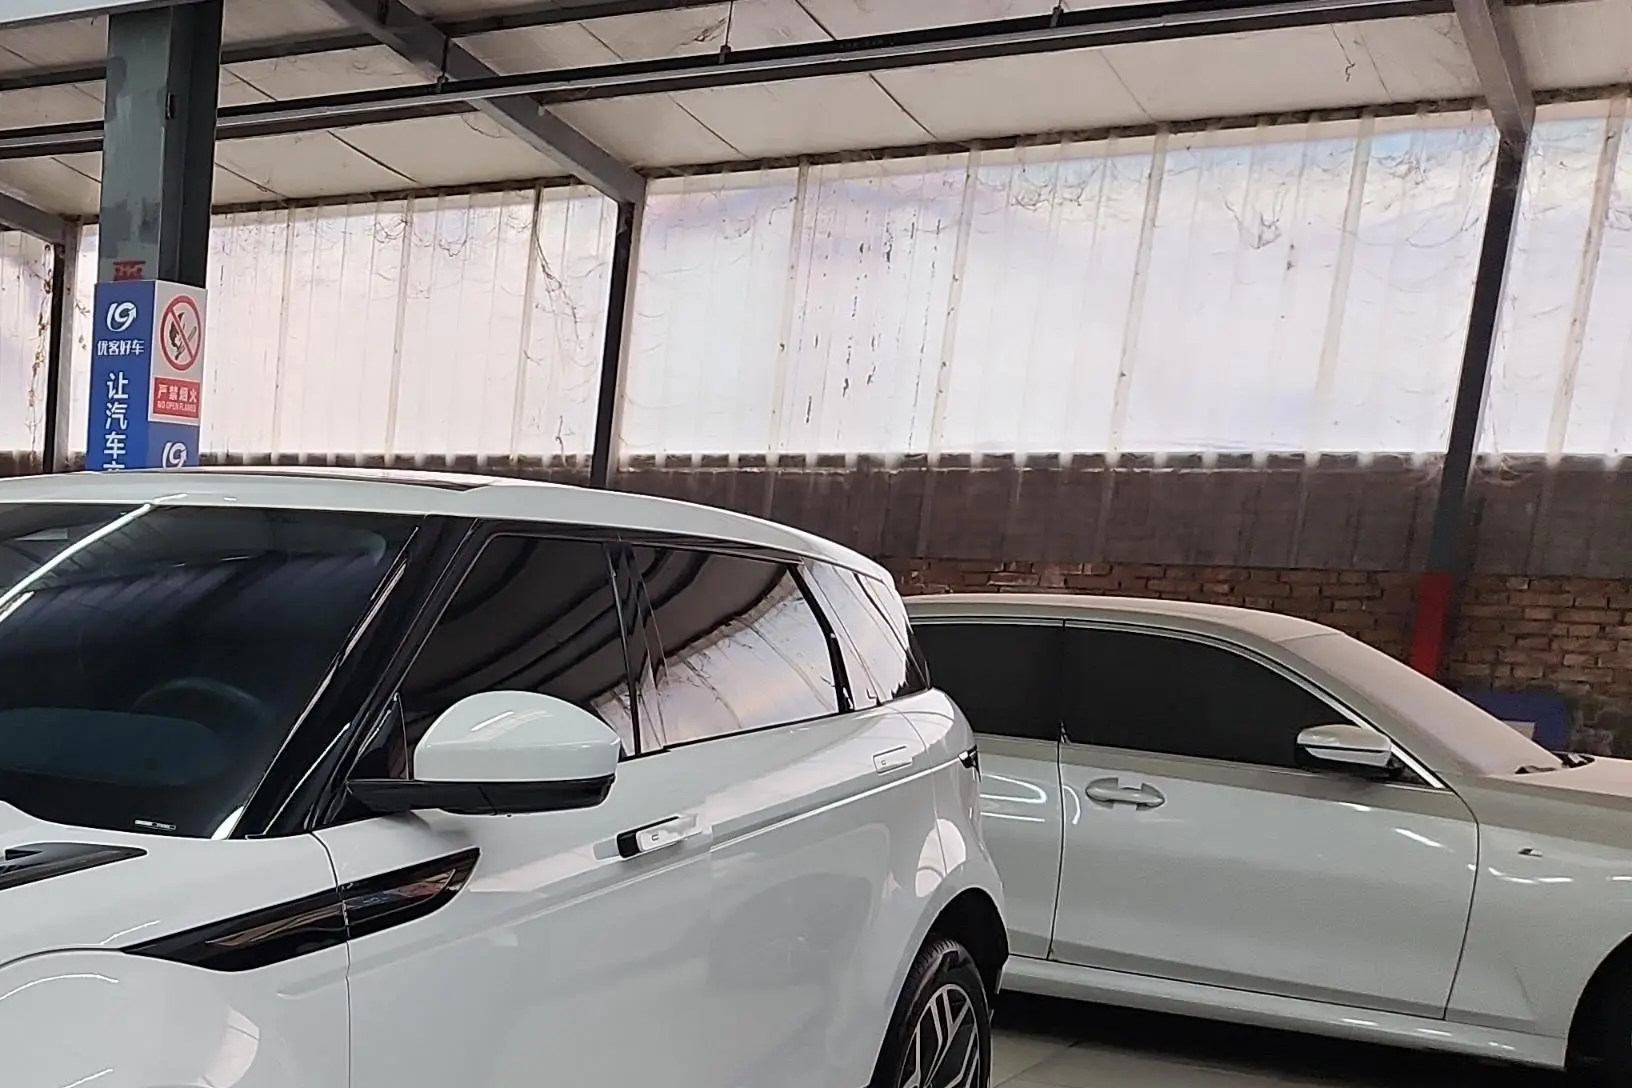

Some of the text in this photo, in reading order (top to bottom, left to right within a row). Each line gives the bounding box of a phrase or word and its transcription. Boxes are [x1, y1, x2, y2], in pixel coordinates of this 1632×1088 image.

[97, 340, 144, 355] 优客好车
[158, 383, 197, 403] 严禁烟火
